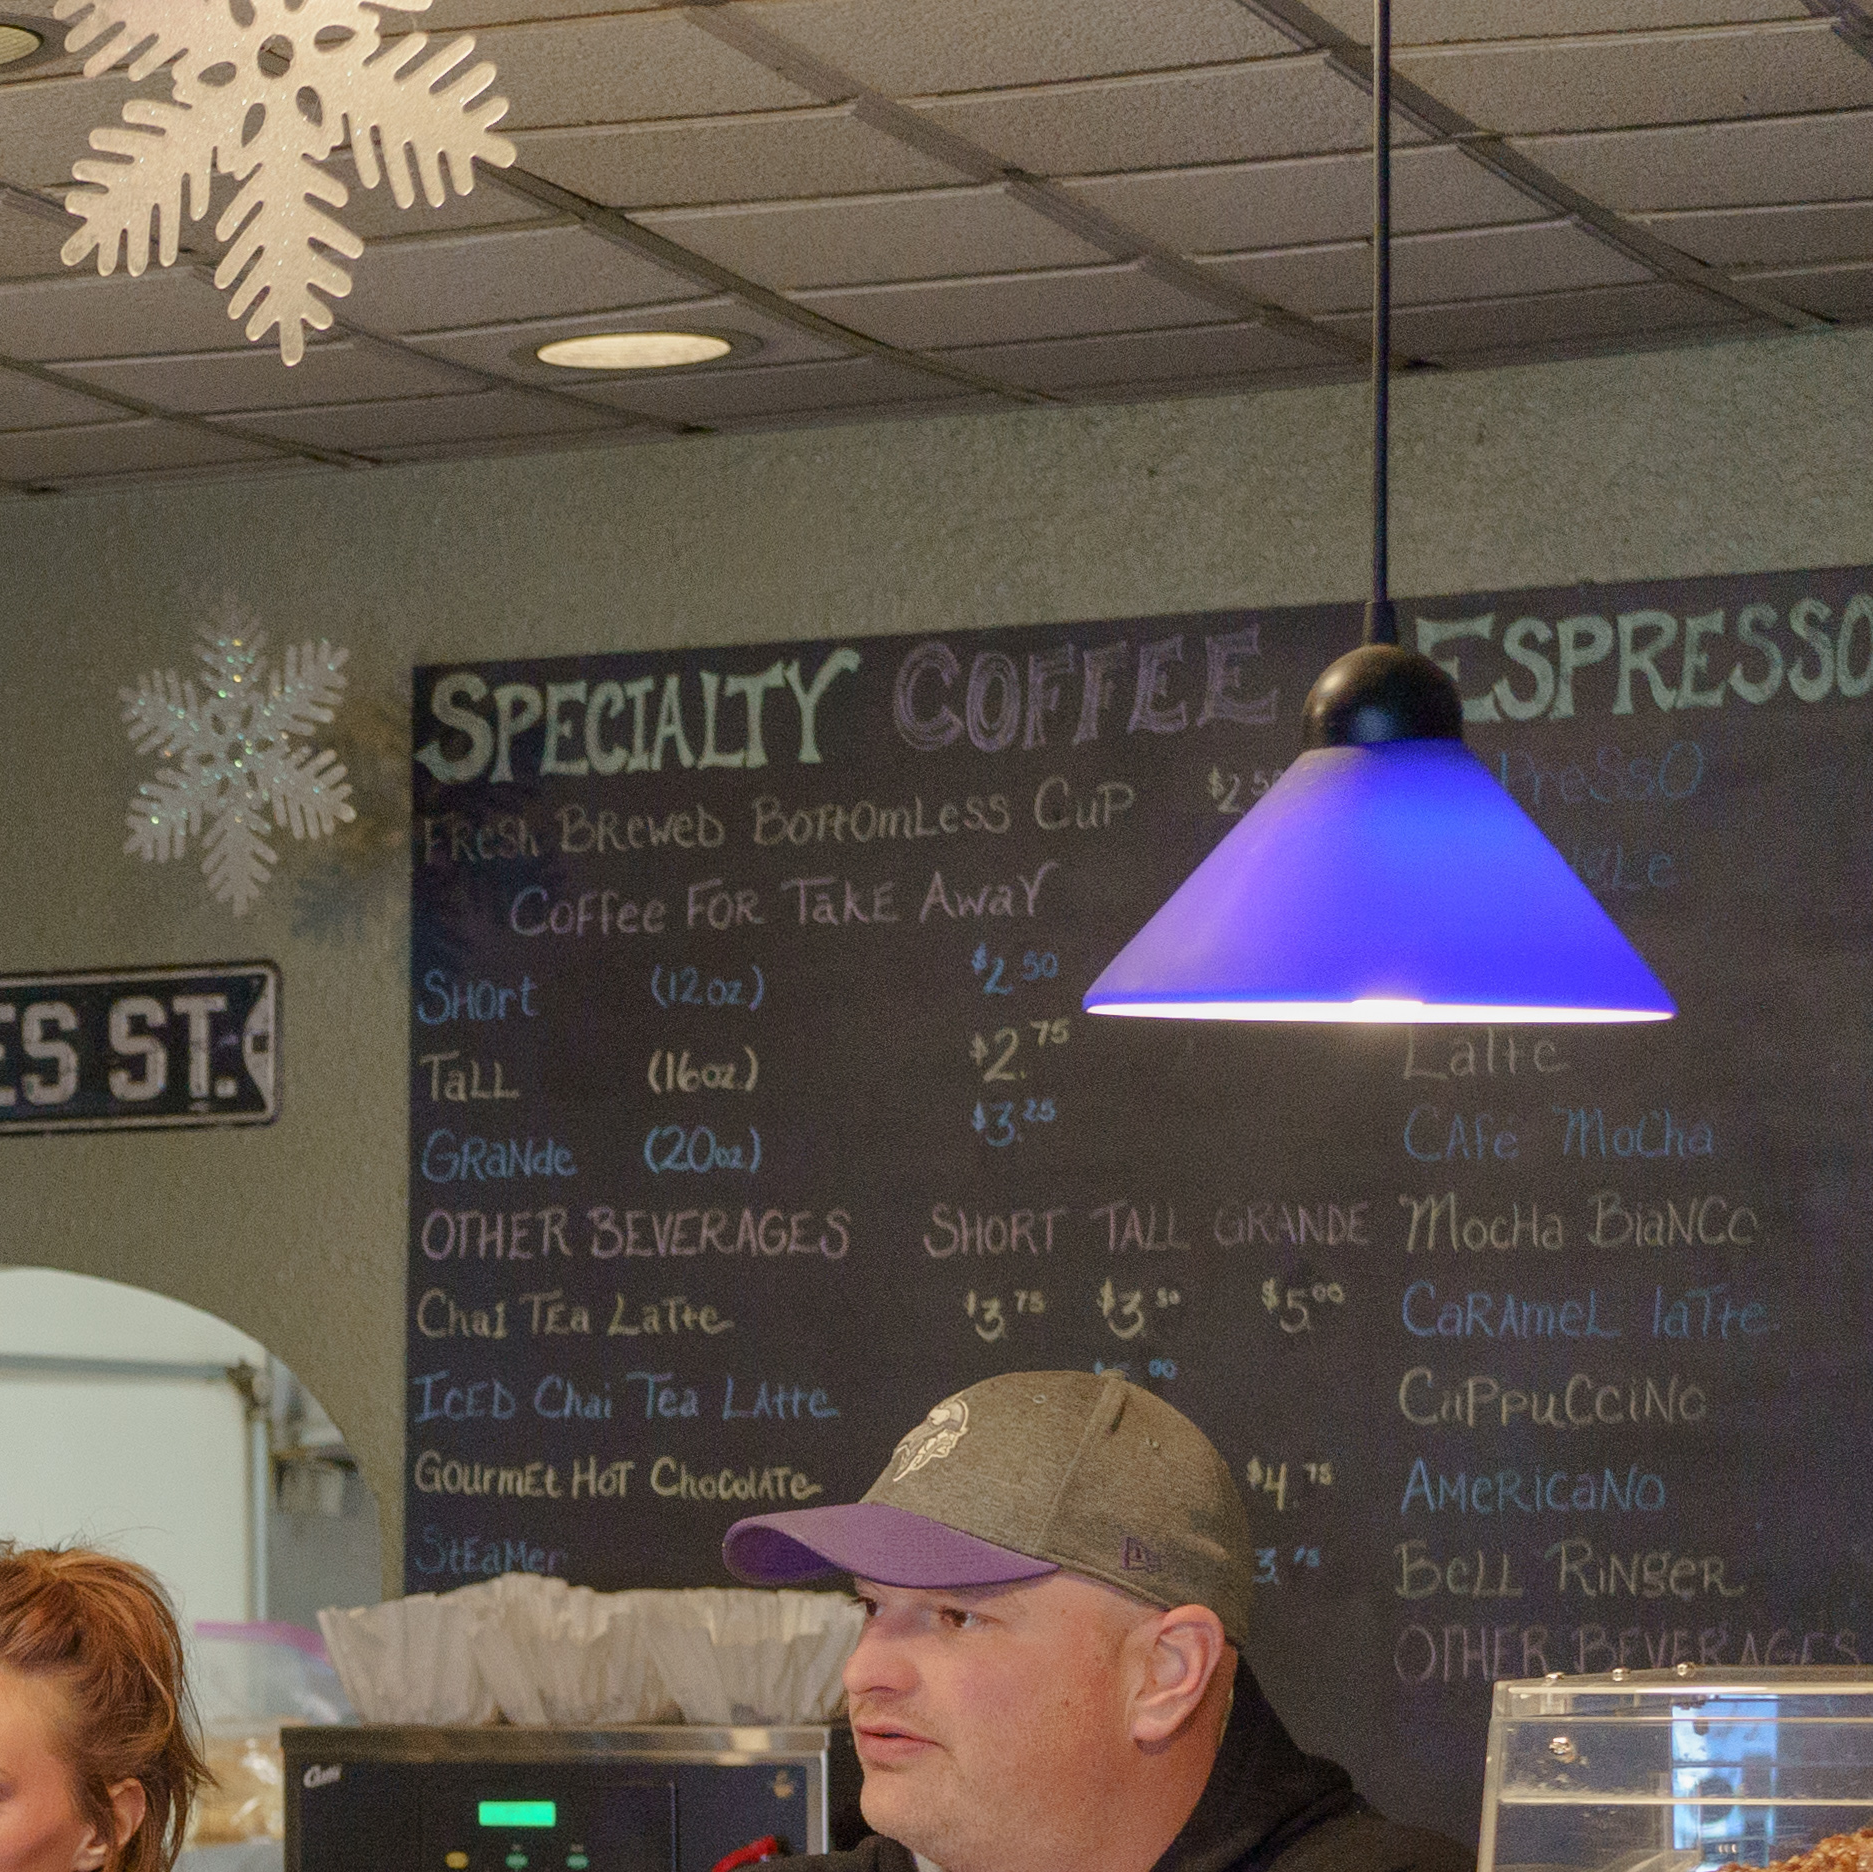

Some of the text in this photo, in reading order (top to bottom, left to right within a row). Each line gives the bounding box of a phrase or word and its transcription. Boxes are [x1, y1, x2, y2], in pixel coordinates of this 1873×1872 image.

[414, 648, 860, 783] SPECIALTY
[894, 625, 1279, 753] COFFEE
[108, 992, 238, 1104] ST.
[421, 1207, 854, 1262] OTHER BEVERAGES
[923, 1199, 1371, 1258] SHORT TALL GRANDE
[1395, 1623, 1549, 1685] OTHER
